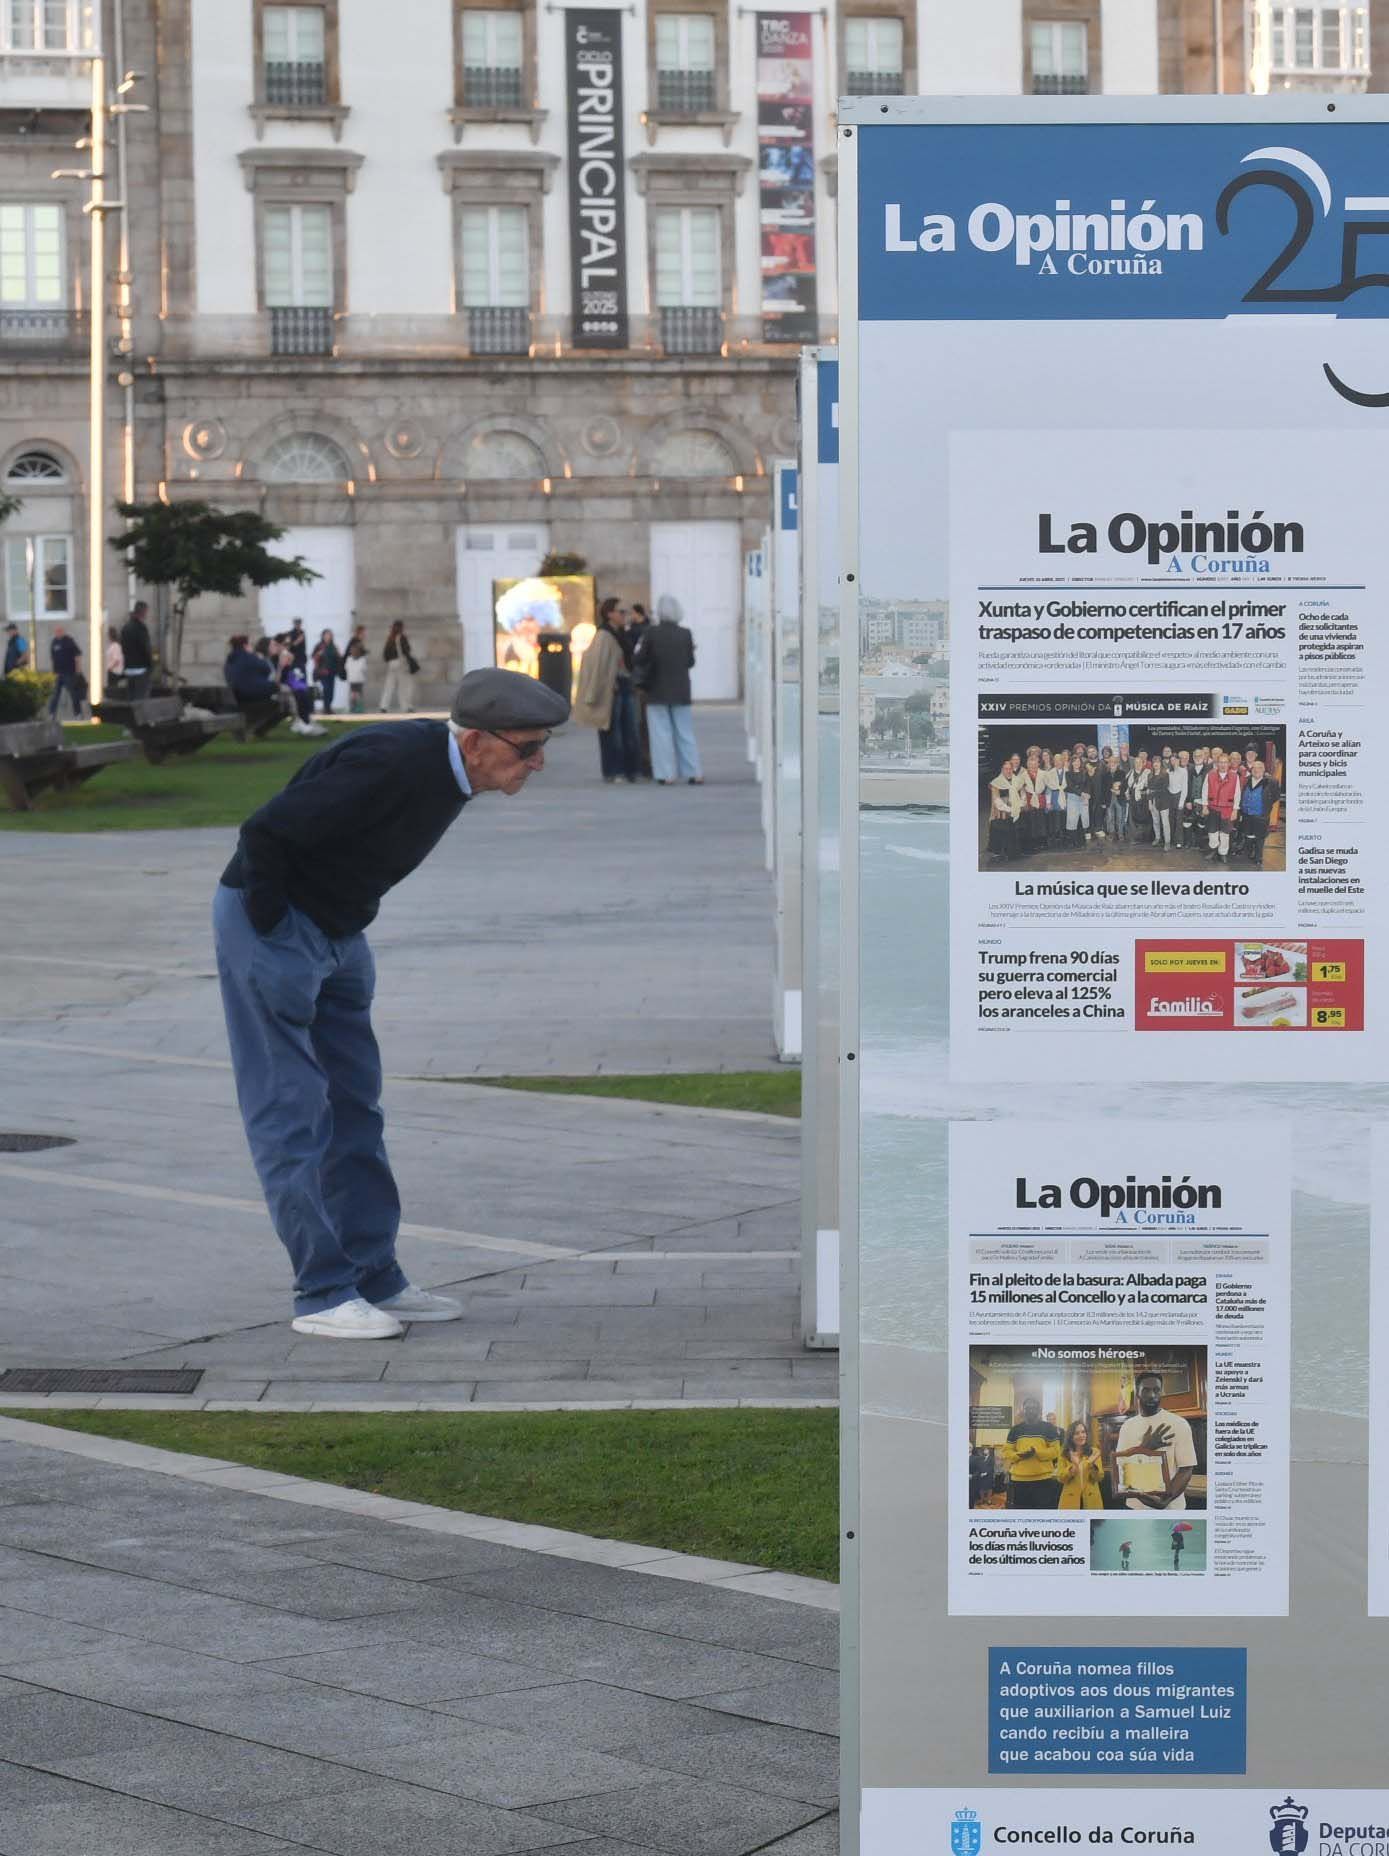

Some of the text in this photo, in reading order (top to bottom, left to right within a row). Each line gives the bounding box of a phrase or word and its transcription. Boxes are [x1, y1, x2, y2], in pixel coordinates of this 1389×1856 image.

[577, 64, 617, 288] PRINCIPAL
[885, 203, 956, 252] La
[968, 199, 1203, 265] Opinión
[1038, 253, 1163, 275] A Coruña
[1039, 510, 1304, 565] La Opinión
[1166, 554, 1270, 573] A Coruña
[978, 600, 1287, 621] Xunta y Gobierno certifican el primer
[1299, 613, 1349, 621] Ocho de cada
[978, 623, 1286, 643] traspaso de competencias en 17 años
[980, 703, 1006, 712] XXIV
[1009, 703, 1051, 712] PREMIOS
[1098, 703, 1111, 712] DA
[1126, 701, 1164, 712] MÚSICA
[1167, 703, 1181, 712] DE
[1184, 701, 1209, 712] RAÍZ
[1299, 730, 1306, 738] A
[1307, 729, 1336, 738] Coruña
[1298, 740, 1329, 748] Arteixo
[1298, 750, 1358, 759] para coordinar
[1298, 769, 1347, 778] municipales
[1015, 881, 1249, 899] La música que se lleva dentro
[978, 951, 1120, 966] Trump frena 90 días
[978, 969, 1117, 985] su guerra comercial
[978, 986, 1112, 1002] pero eleva al 125%
[978, 1004, 1125, 1018] los aranceles a China
[1016, 1176, 1221, 1217] La Opinión
[1115, 1210, 1195, 1224] A Coruña
[969, 1273, 1207, 1289] Fin al pleito de la basura: Albada paga
[970, 1290, 1208, 1306] 15 millones al Concello y a la comarca
[1031, 1348, 1146, 1359] «No somos héroes»
[969, 1527, 1076, 1538] A Coruña vive uno de
[969, 1540, 1073, 1551] los días más lluviosos
[969, 1554, 1085, 1565] de los últimos cien años
[1000, 1661, 1175, 1675] A Coruña nomea fillos
[1000, 1683, 1235, 1699] adoptivos aos dous migrantes
[1000, 1705, 1232, 1721] que auxiliarion a Samuel Luiz
[1000, 1726, 1189, 1740] cando recibíu a malleira
[1000, 1747, 1195, 1764] que acabou coa súa vida
[993, 1826, 1195, 1844] Concello da Coruña
[1320, 1843, 1389, 1856] DA COR
